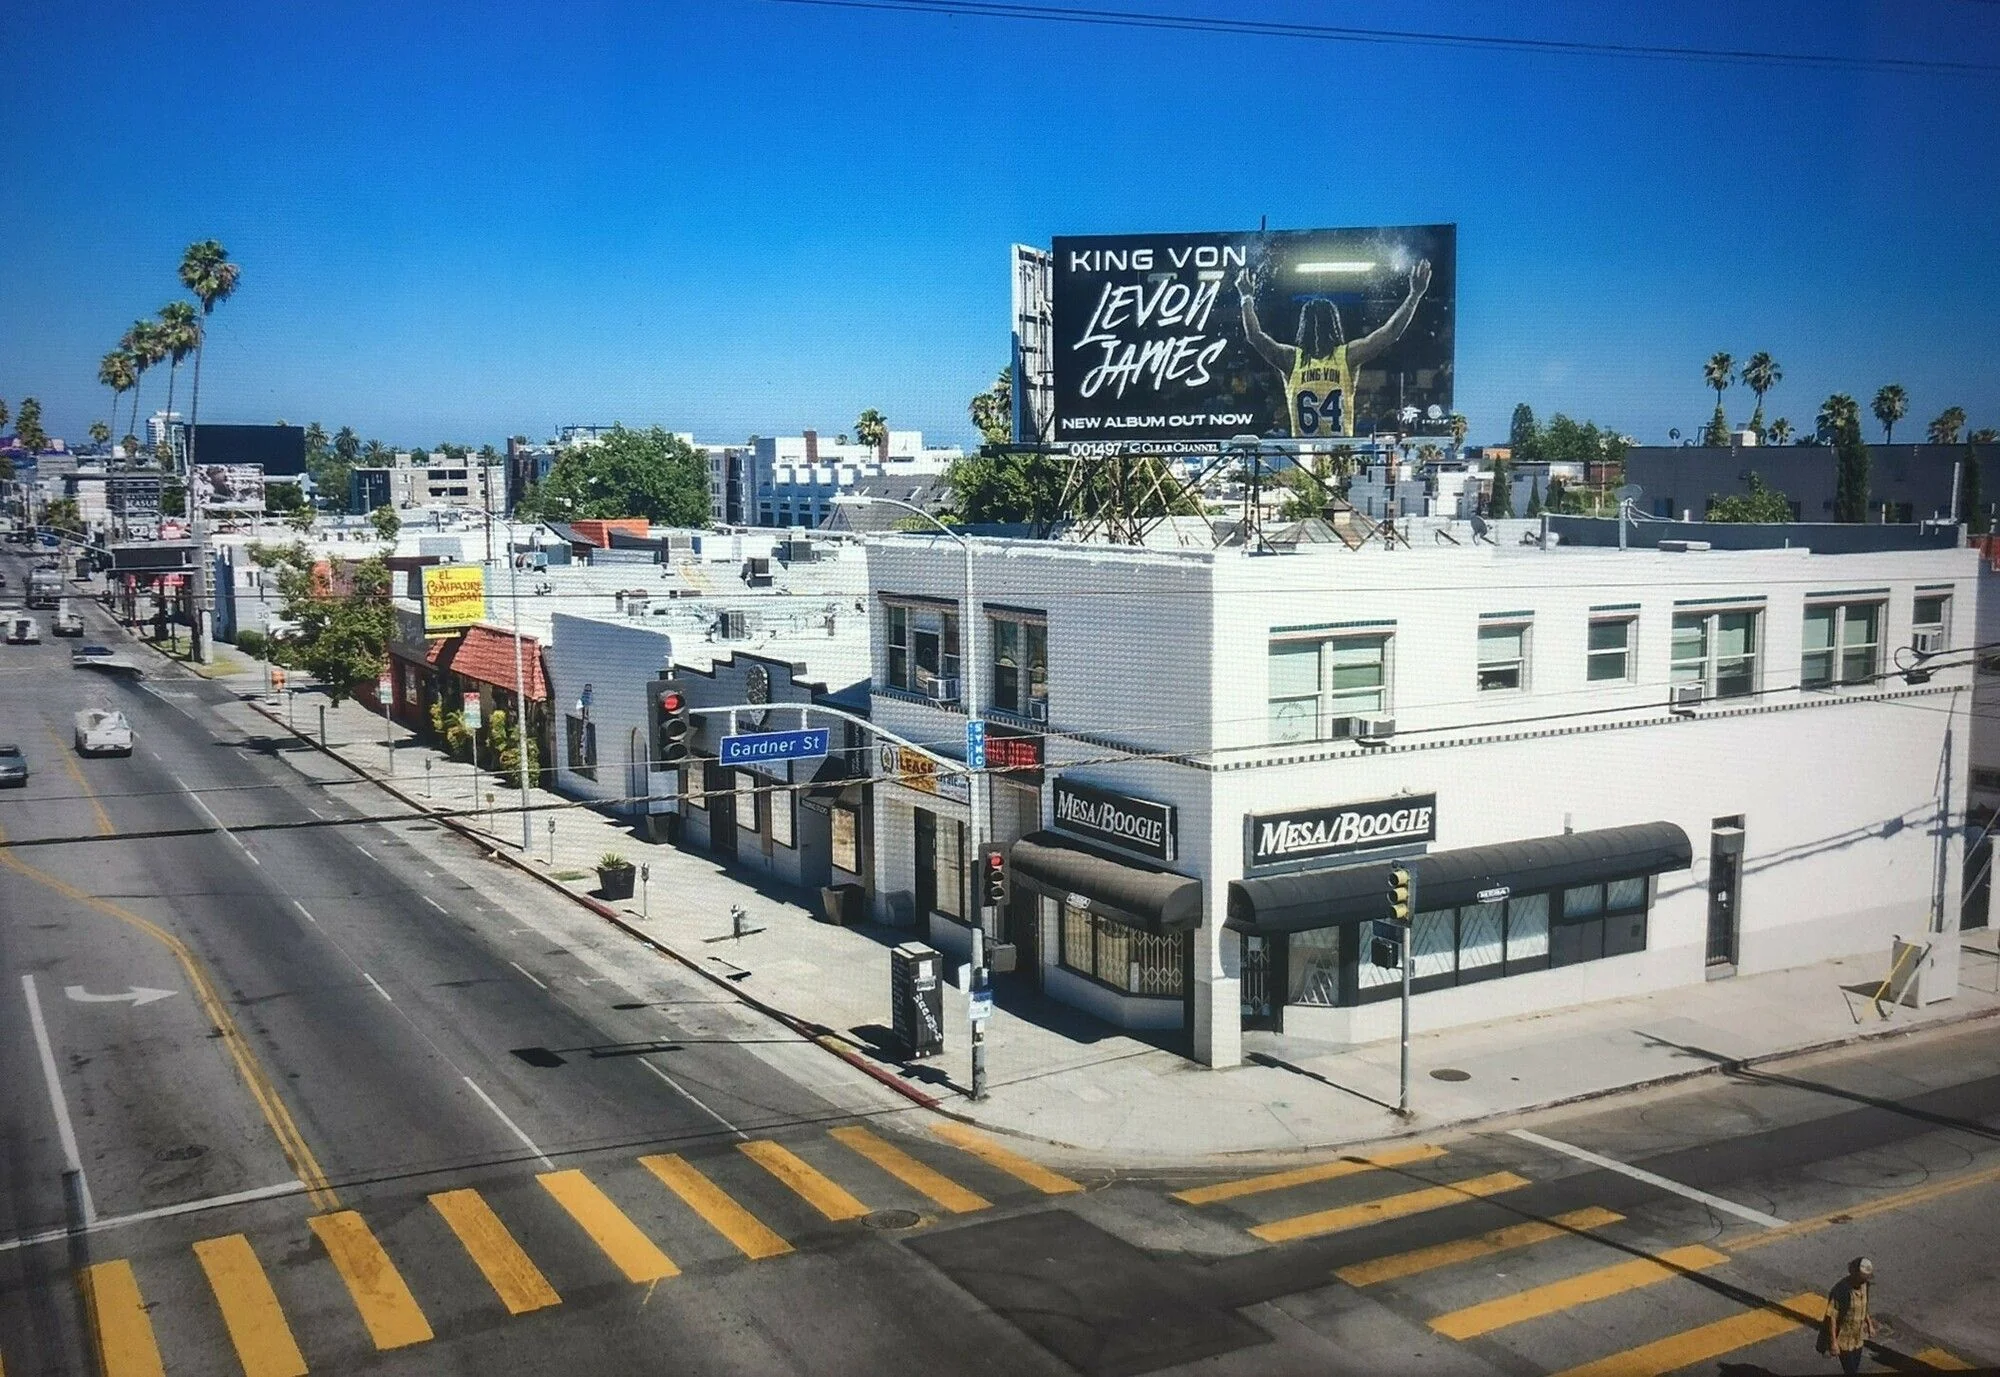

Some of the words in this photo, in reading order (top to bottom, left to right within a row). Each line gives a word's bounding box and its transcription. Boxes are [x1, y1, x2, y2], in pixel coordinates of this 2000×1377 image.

[1071, 249, 1154, 272] KING
[1168, 245, 1247, 268] VON
[1073, 278, 1221, 351] LEVON
[1080, 335, 1228, 399] JAMES
[1301, 368, 1321, 384] KING
[1324, 367, 1340, 384] VON
[1062, 417, 1101, 430] NEW
[1104, 415, 1166, 428] ALBUM
[1168, 414, 1206, 427] OUT
[1209, 413, 1254, 426] NOW
[1297, 389, 1342, 434] 64
[1070, 443, 1122, 457] 001497
[439, 570, 452, 580] EL
[429, 592, 481, 608] RESTAURANT
[258, 612, 269, 620] 30
[432, 612, 480, 620] MEXICAN
[730, 740, 797, 757] Gardner
[803, 736, 820, 750] St
[899, 752, 934, 775] LEASE
[1057, 790, 1163, 846] MESA/BOOGIE
[1257, 807, 1432, 856] MESA/BOOGIE
